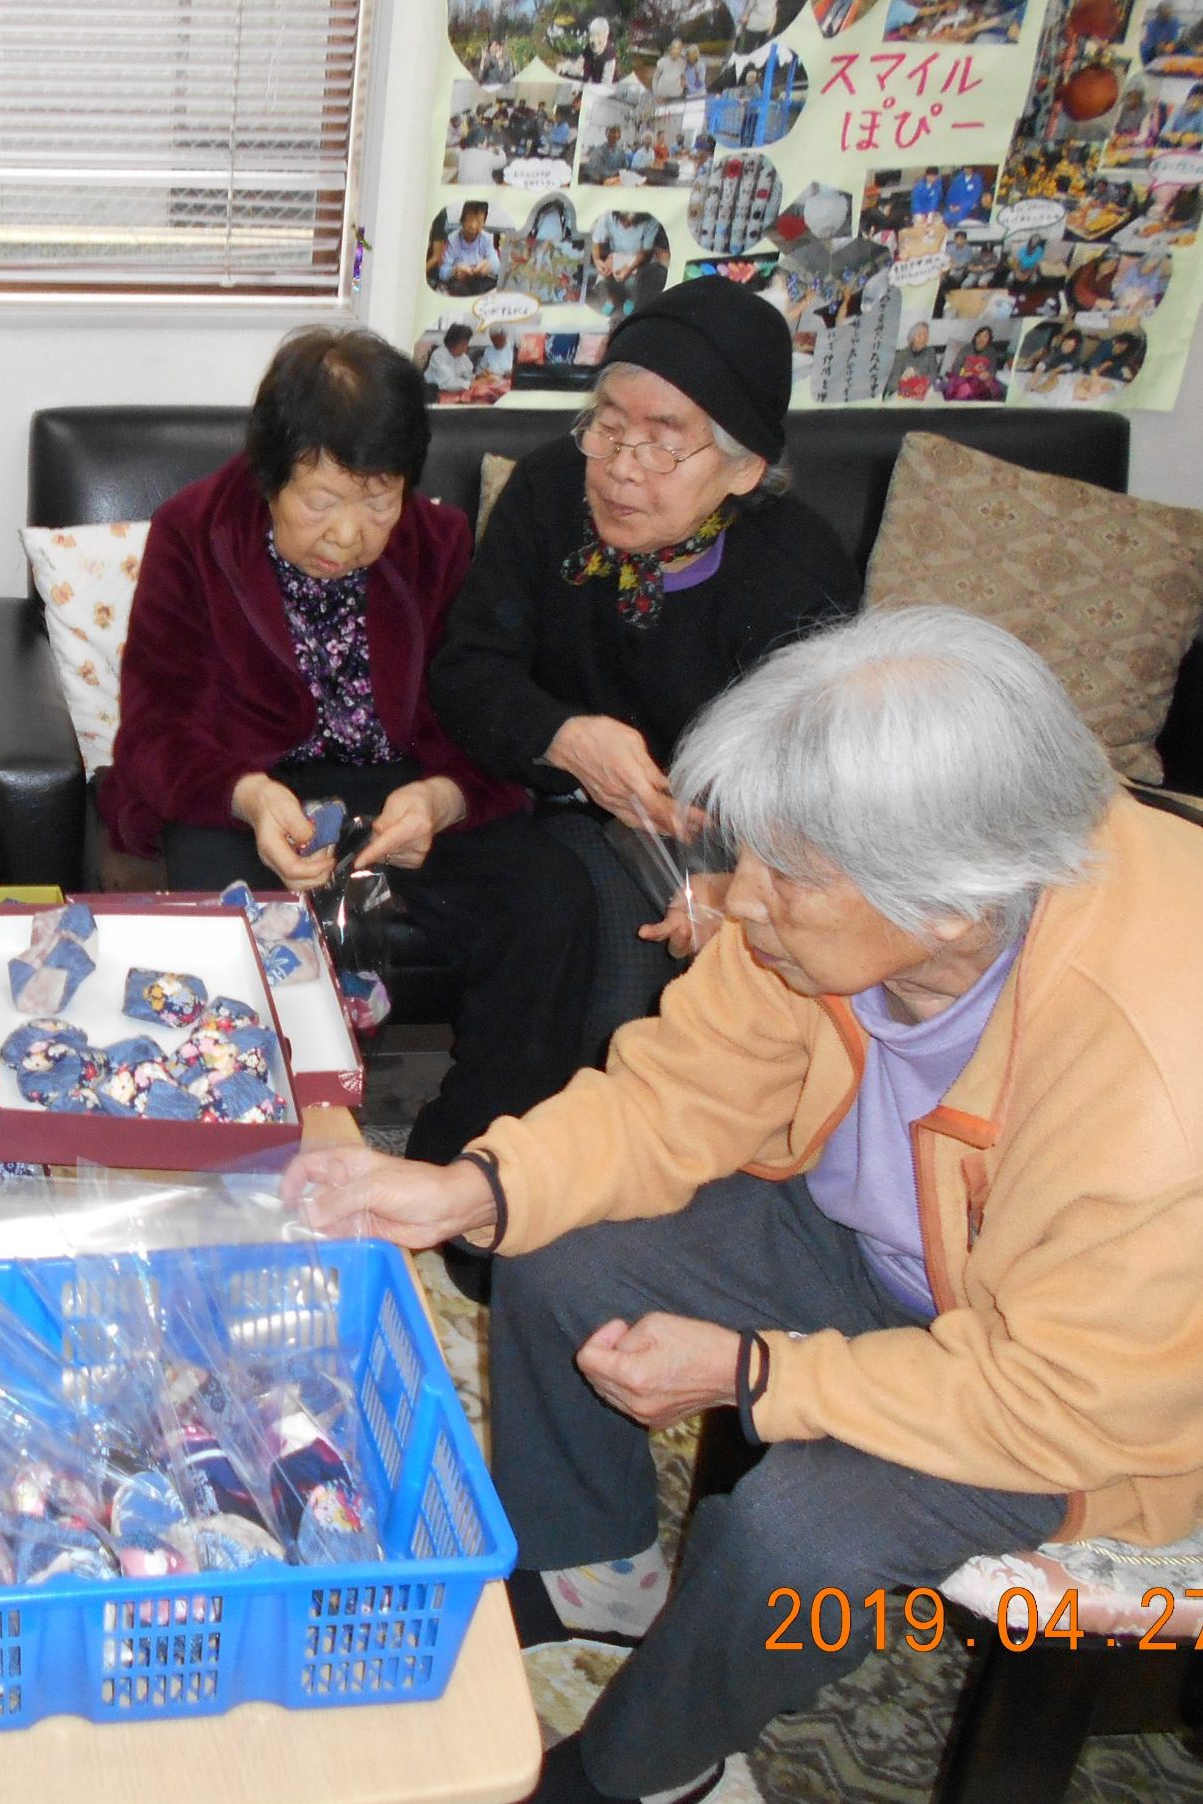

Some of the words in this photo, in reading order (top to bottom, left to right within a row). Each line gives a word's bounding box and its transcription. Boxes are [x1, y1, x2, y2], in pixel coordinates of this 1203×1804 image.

[820, 52, 984, 96] スマイル
[840, 96, 986, 152] ぽぴー
